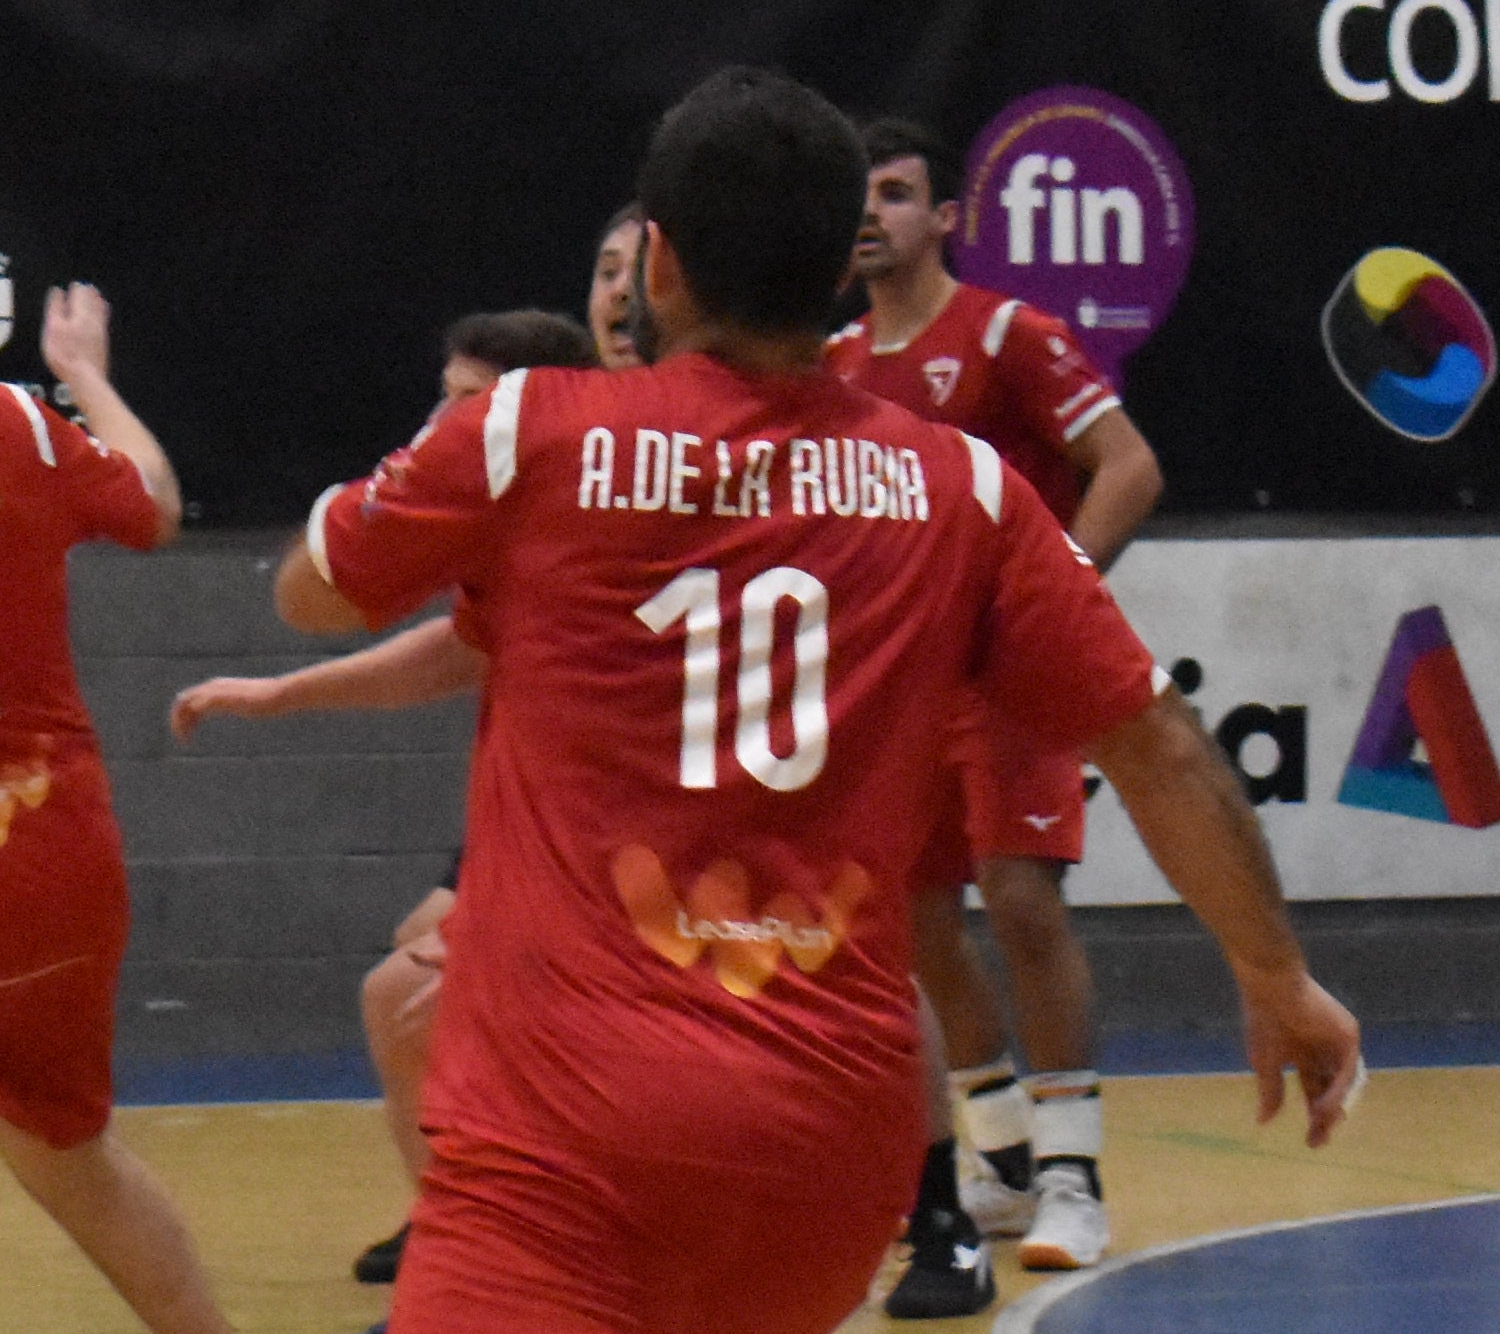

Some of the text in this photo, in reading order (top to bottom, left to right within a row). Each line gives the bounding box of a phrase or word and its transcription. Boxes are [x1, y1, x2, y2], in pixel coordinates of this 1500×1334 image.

[1000, 153, 1144, 266] fin
[712, 439, 776, 518] LA
[790, 437, 930, 522] RUBIA
[634, 566, 829, 792] 10
